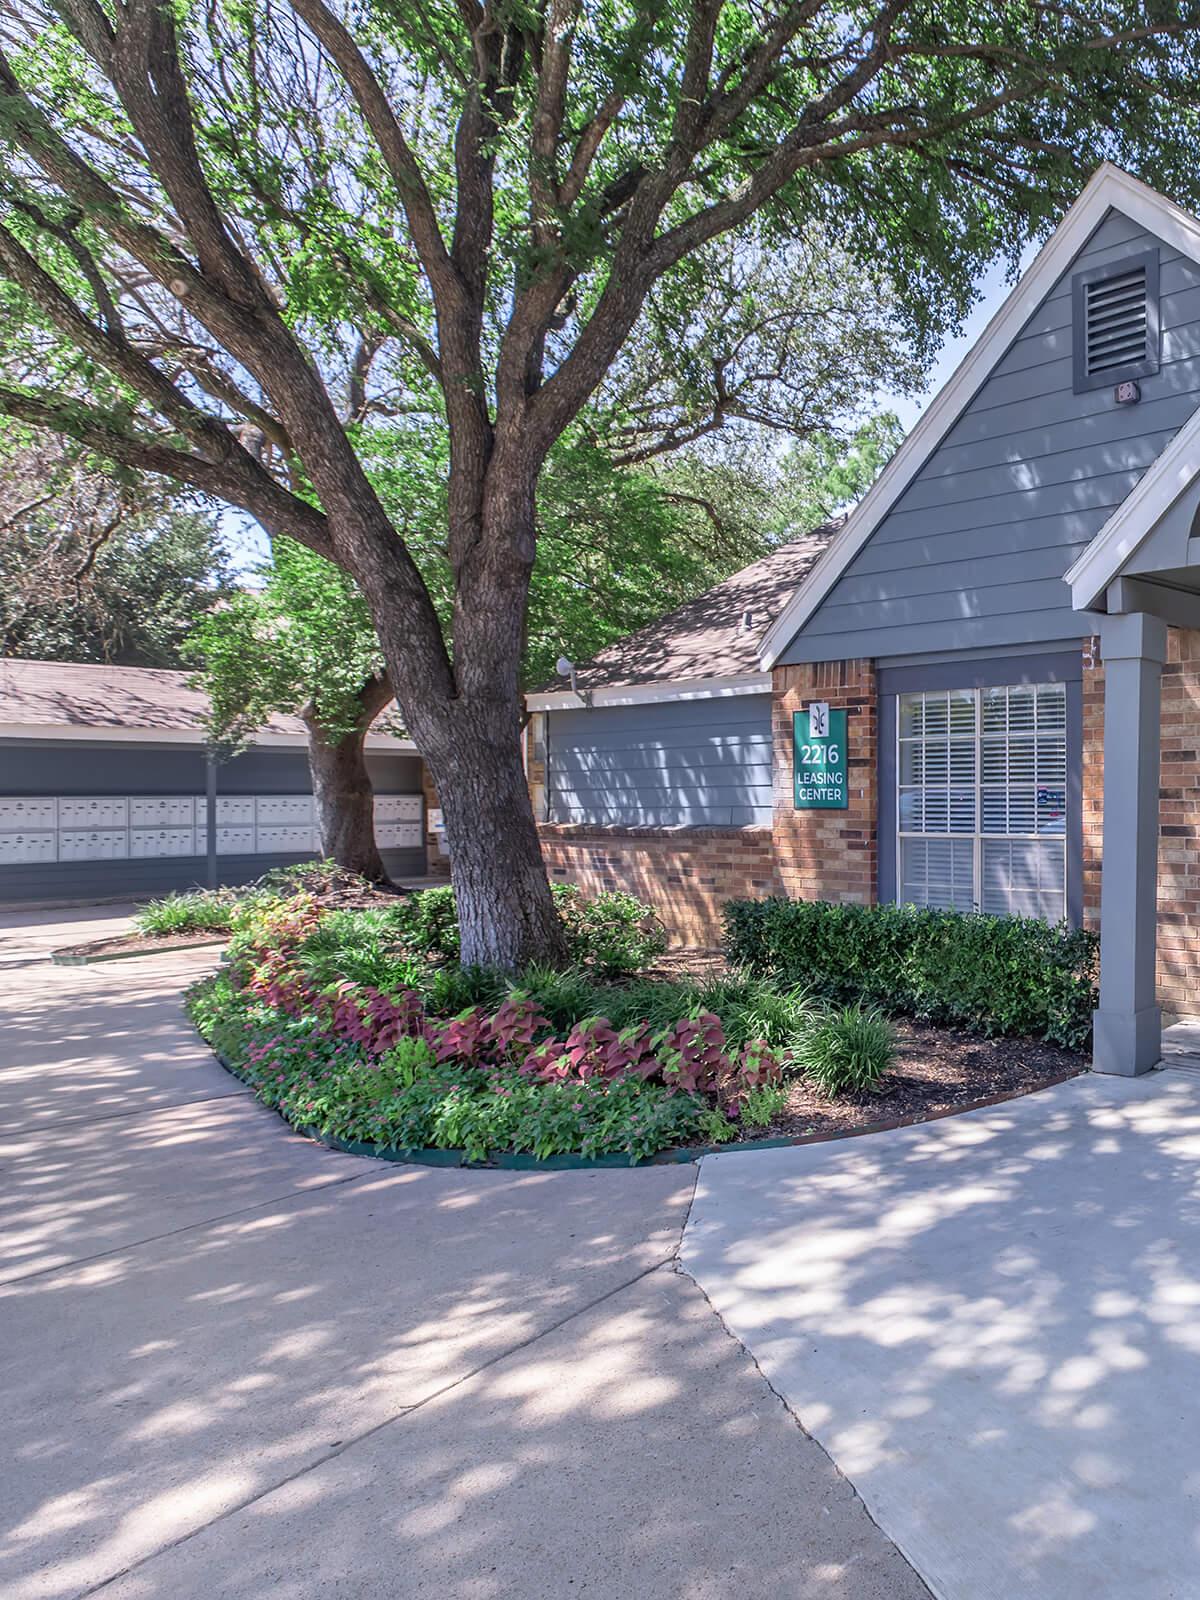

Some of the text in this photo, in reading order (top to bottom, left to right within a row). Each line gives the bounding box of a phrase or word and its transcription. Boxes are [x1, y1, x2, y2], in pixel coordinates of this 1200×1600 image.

[801, 744, 839, 764] 2216
[797, 772, 843, 785] LEASING
[799, 788, 842, 801] CENTER
